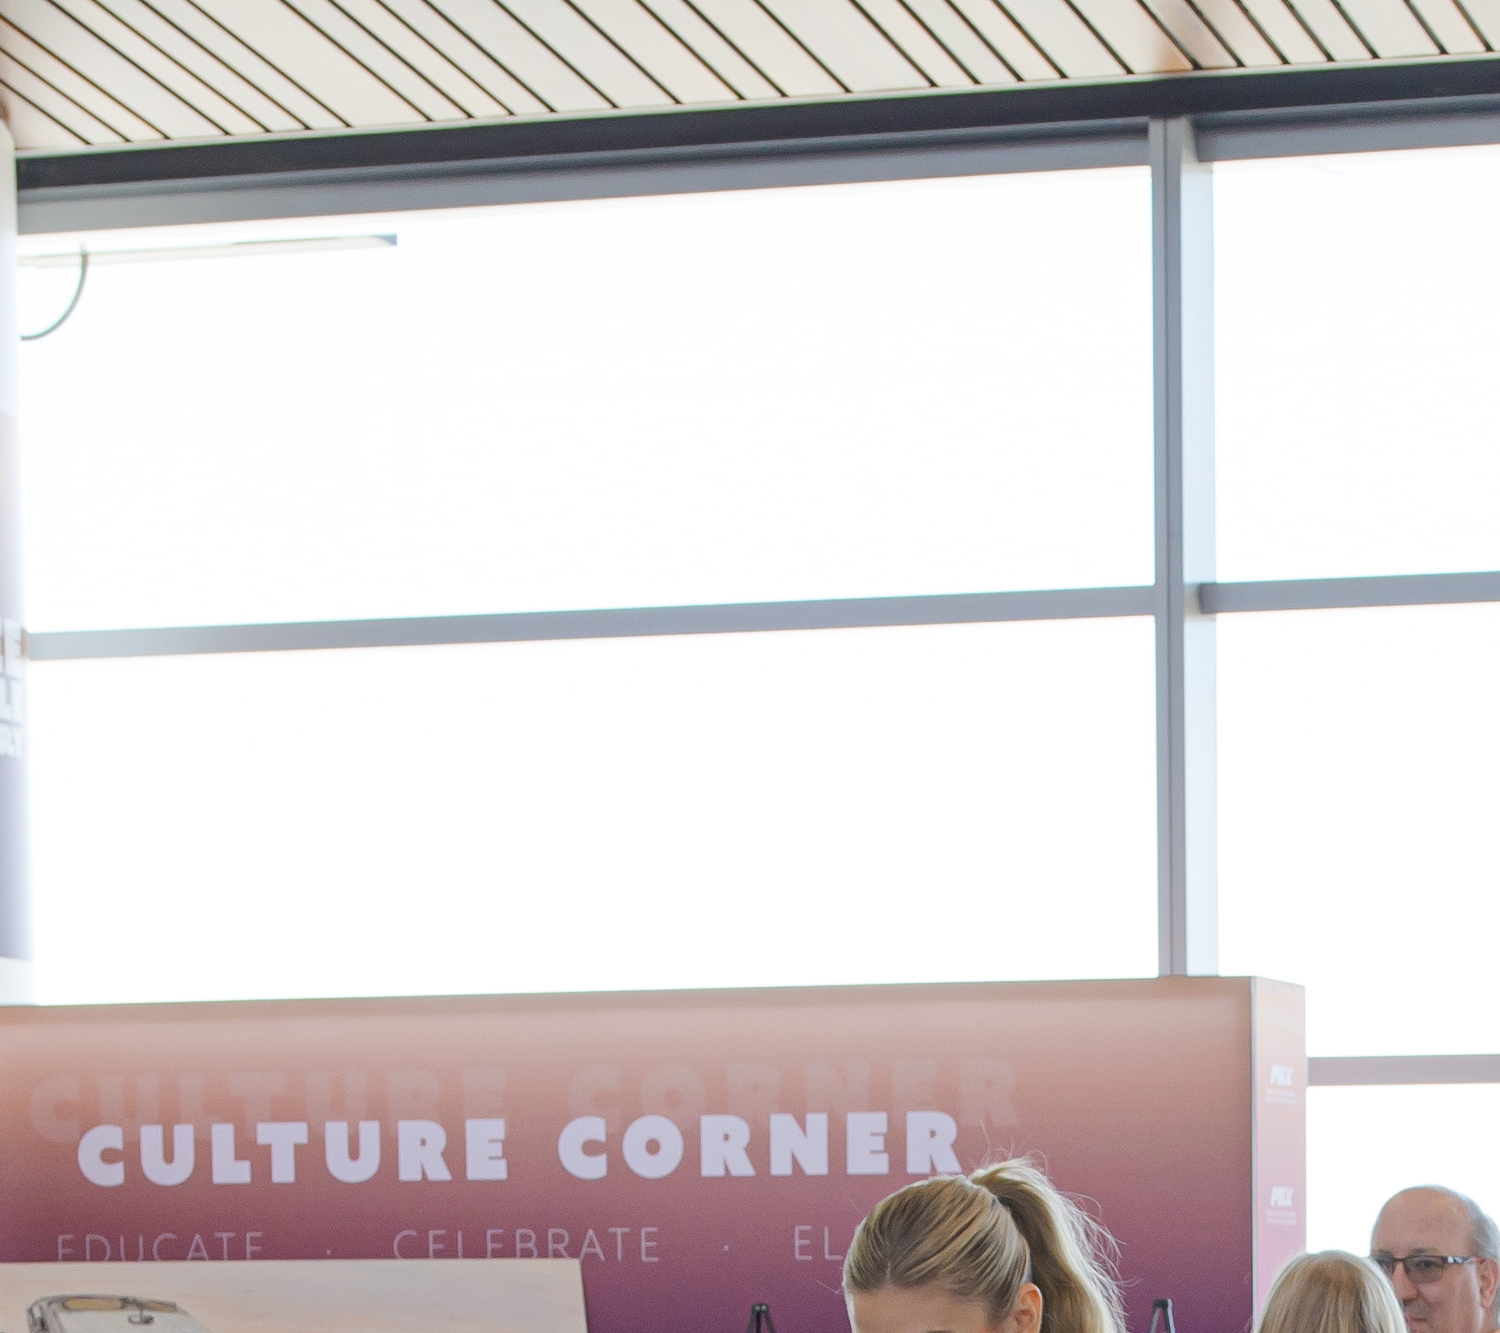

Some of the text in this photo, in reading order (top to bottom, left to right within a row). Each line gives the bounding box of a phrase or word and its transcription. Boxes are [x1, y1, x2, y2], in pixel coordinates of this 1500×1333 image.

[78, 1109, 962, 1187] CULTURE CORNER
[56, 1231, 264, 1262] EDUCATE
